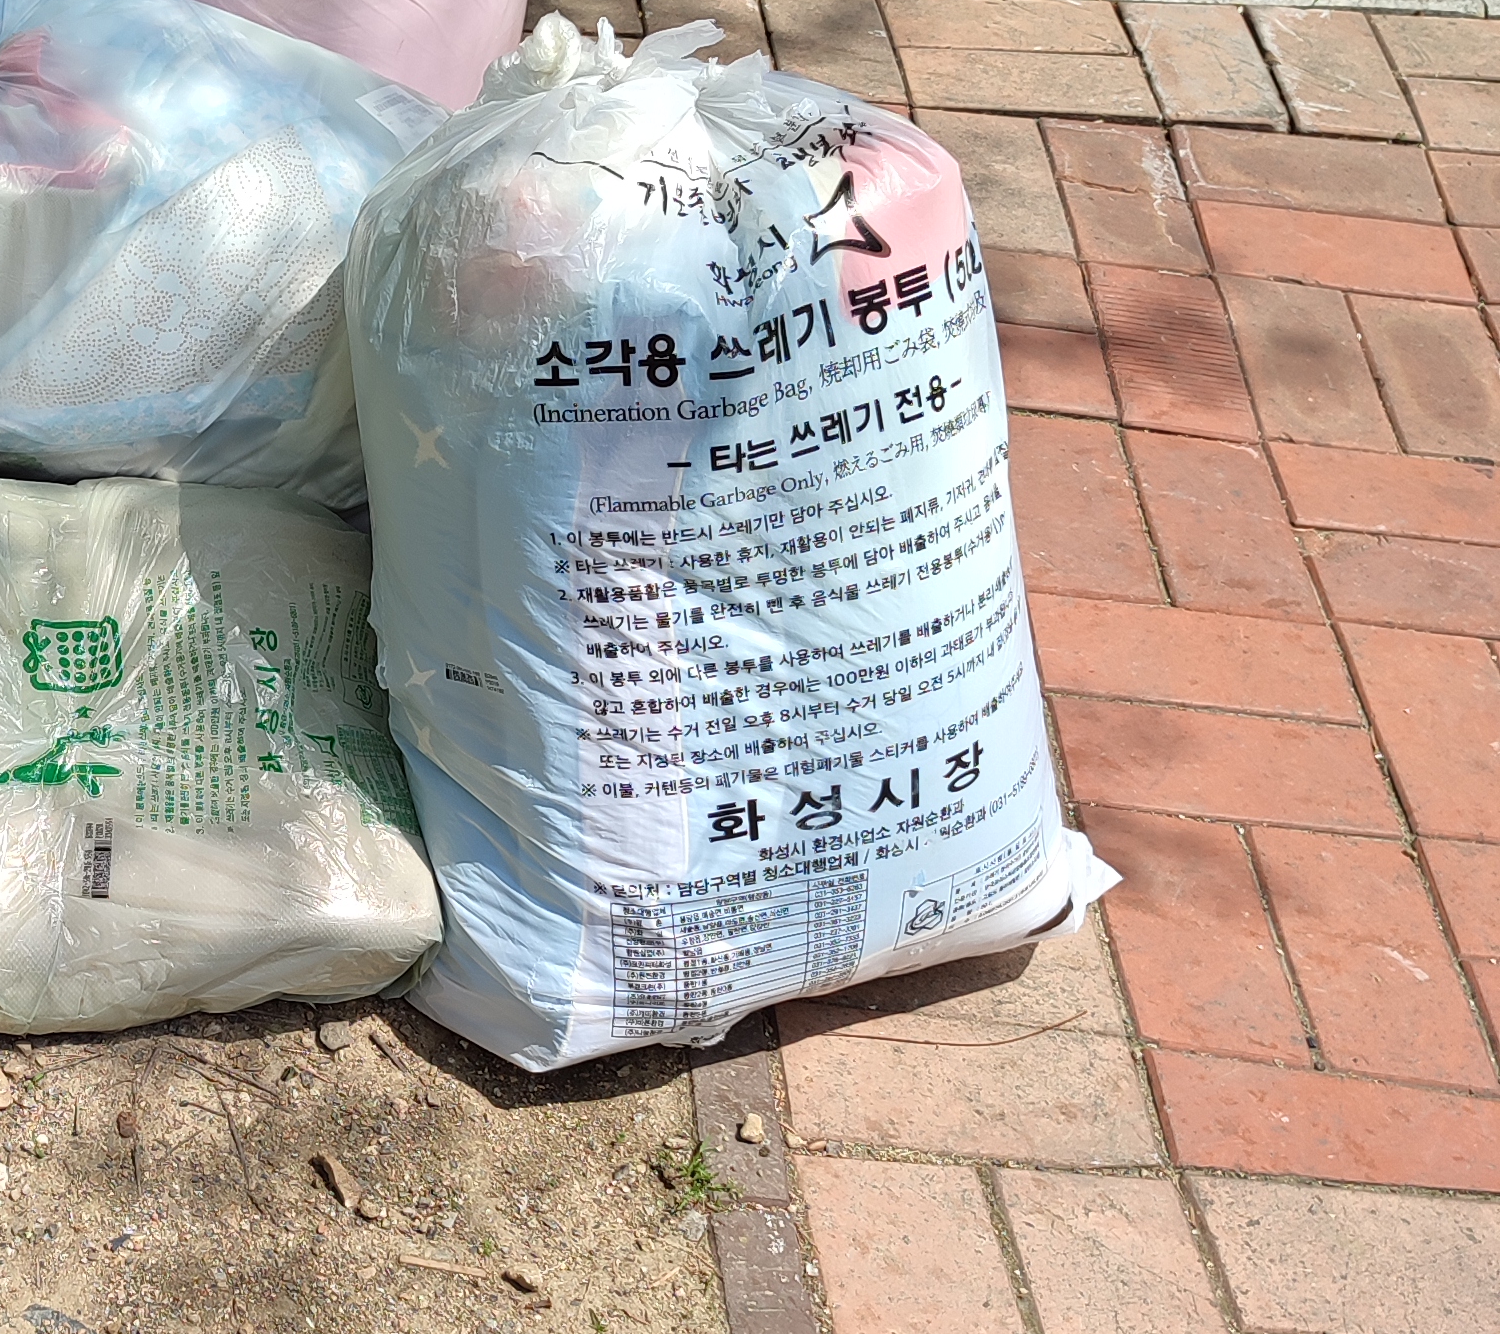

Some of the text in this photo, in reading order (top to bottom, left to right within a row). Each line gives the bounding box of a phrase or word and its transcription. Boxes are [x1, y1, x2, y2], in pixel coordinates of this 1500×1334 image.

[534, 334, 687, 388] 소각용
[709, 298, 837, 381] 쓰레기
[848, 264, 933, 335] 봉투
[533, 403, 671, 426] (Incineration
[677, 391, 768, 418] Garbage
[774, 378, 814, 405] Bag,
[710, 439, 779, 473] 타는
[790, 399, 885, 458] 쓰레기
[567, 532, 583, 547] 이
[589, 531, 656, 547] 봉투에는
[662, 525, 712, 545] 반드시
[718, 511, 785, 537] 쓰레기만
[791, 503, 823, 524] 담아
[828, 485, 894, 516] 주십시오.
[590, 495, 697, 515] (Flammable
[700, 485, 777, 508] Garbage
[780, 470, 830, 492] Only,
[576, 559, 608, 575] 타는
[613, 556, 662, 572] 쓰레기
[680, 550, 731, 569] 사용한
[737, 543, 774, 562] 휴지,
[780, 526, 843, 555] 재활용이
[849, 516, 895, 539] 안되는
[756, 565, 806, 587] 투명한
[811, 553, 859, 579] 봉투에
[863, 544, 894, 564] 담아
[900, 522, 950, 555] 배출하여
[583, 614, 649, 631] 쓰레기는
[656, 607, 705, 628] 물기를
[711, 600, 760, 620] 완전히
[811, 583, 859, 608] 음식물
[866, 569, 911, 595] 쓰레기
[586, 634, 729, 658] 배출하여 주십시오.
[589, 670, 604, 688] 이
[610, 669, 643, 688] 봉투
[649, 666, 682, 685] 외에
[688, 662, 719, 681] 다른
[724, 655, 772, 675] 봉투를
[779, 644, 844, 667] 사용하여
[850, 628, 911, 656] 쓰레기를
[593, 699, 625, 716] 않고
[631, 694, 696, 715] 혼합하여
[703, 685, 750, 707] 배출한
[756, 676, 821, 699] 경우에는
[827, 663, 890, 688] 100만원
[895, 648, 937, 672] 이하의
[597, 727, 661, 743] 쓰레기는
[667, 722, 700, 741] 수거
[706, 716, 736, 735] 전일
[742, 711, 775, 728] 오후
[780, 701, 839, 723] 8시부터
[846, 693, 876, 713] 수거
[883, 686, 912, 707] 당일
[917, 676, 943, 696] 오전
[599, 722, 883, 769] 또는 지정된 장소에 배출하여 주십시오.
[603, 782, 639, 798] 이불,
[645, 775, 710, 798] 커텐등의
[715, 766, 779, 788] 폐기물은
[784, 751, 864, 776] 대형폐기물
[869, 736, 929, 763] 스티커를
[933, 713, 979, 744] 사용하여
[759, 800, 965, 862] 화성시 환경사업소 자원순환과
[677, 870, 756, 897] 담당구역별
[763, 851, 859, 882] 청소대행업체
